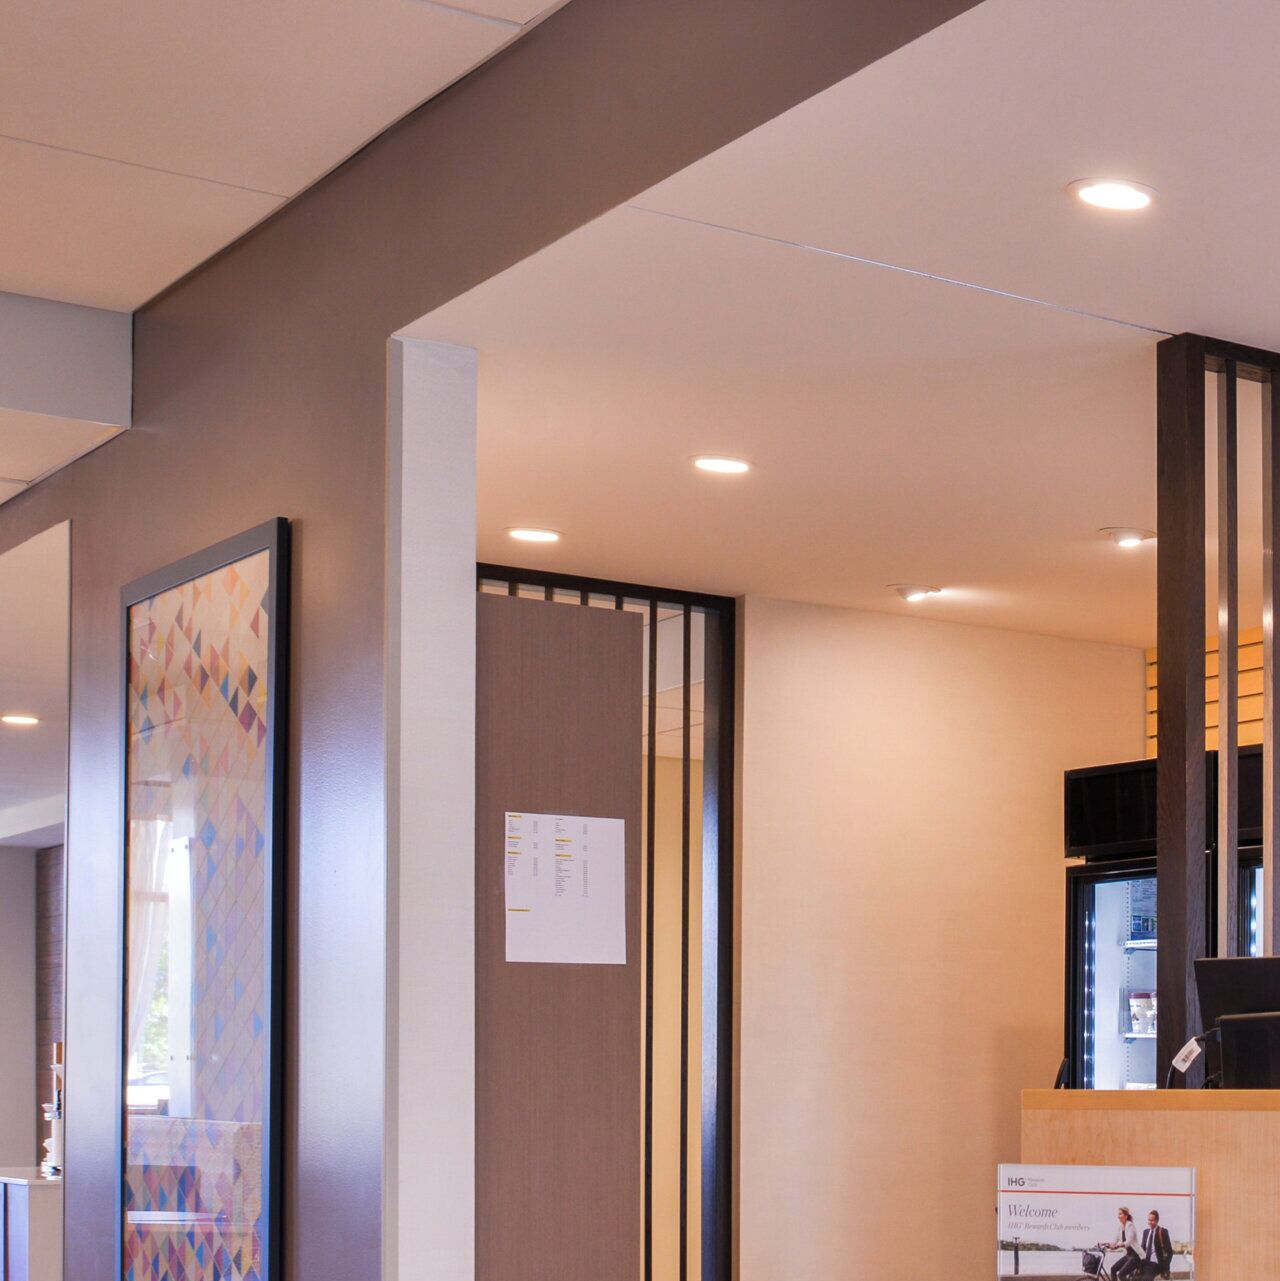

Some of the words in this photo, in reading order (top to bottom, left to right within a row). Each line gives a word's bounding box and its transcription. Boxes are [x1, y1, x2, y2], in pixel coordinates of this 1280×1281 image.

[1007, 1177, 1026, 1187] IHG
[1008, 1203, 1058, 1218] Welcome
[1049, 1223, 1064, 1231] Club
[1064, 1223, 1091, 1232] members
